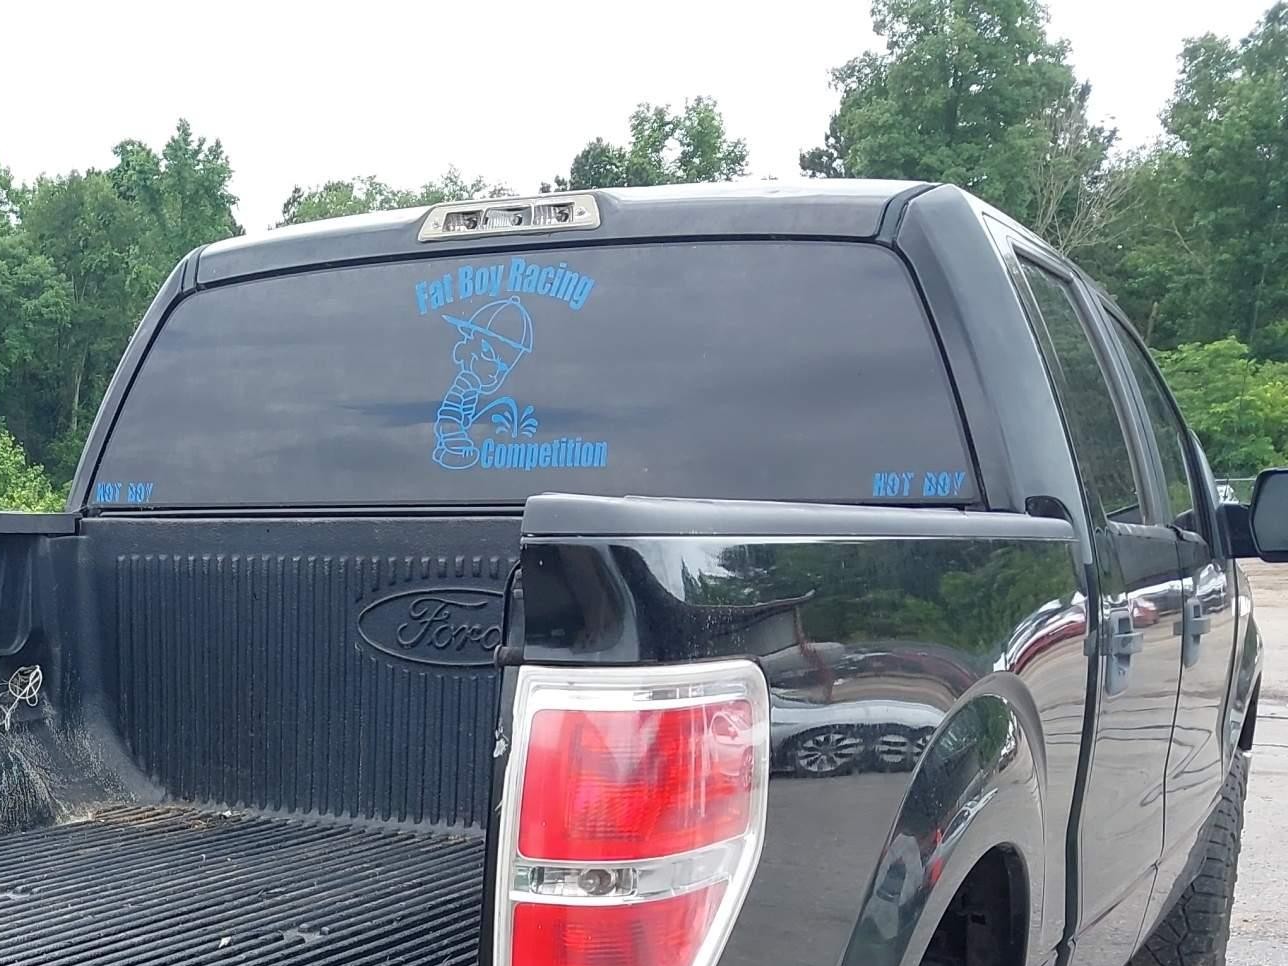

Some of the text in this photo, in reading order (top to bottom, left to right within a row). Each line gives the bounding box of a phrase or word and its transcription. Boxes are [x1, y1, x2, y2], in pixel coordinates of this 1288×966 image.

[415, 257, 595, 315] Fat Boy Racing
[480, 437, 608, 471] Competition
[873, 471, 966, 497] HOT BOY
